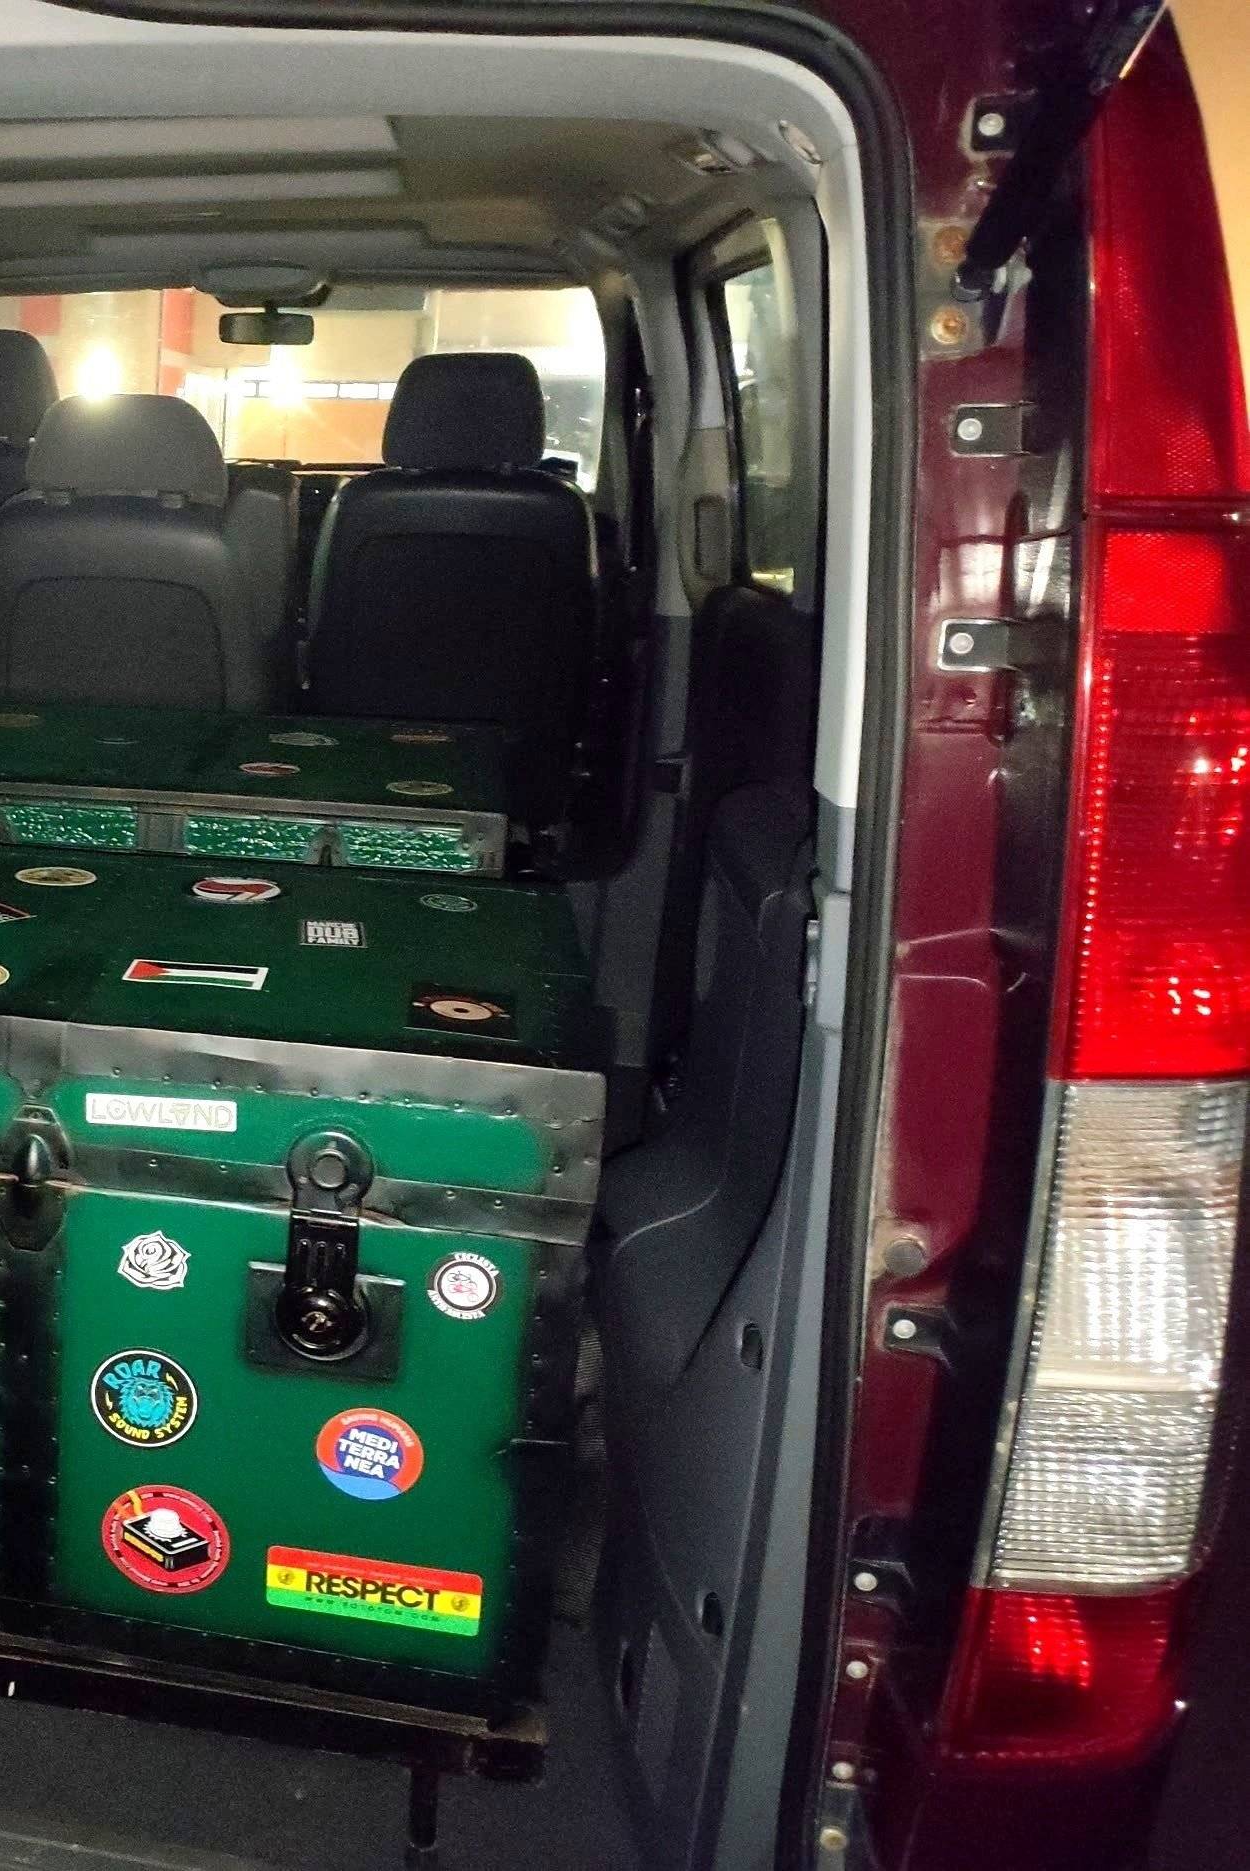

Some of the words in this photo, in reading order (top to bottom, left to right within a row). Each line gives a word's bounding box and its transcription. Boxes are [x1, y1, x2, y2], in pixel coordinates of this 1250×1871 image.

[306, 927, 359, 938] DUB
[102, 1359, 162, 1390] ROAR
[108, 1412, 151, 1440] SOUND
[153, 1396, 188, 1439] SYSTEM
[339, 1439, 400, 1469] TERRA
[350, 1429, 398, 1453] MEDI
[344, 1455, 384, 1478] NEA
[305, 1570, 441, 1611] RESPECT
